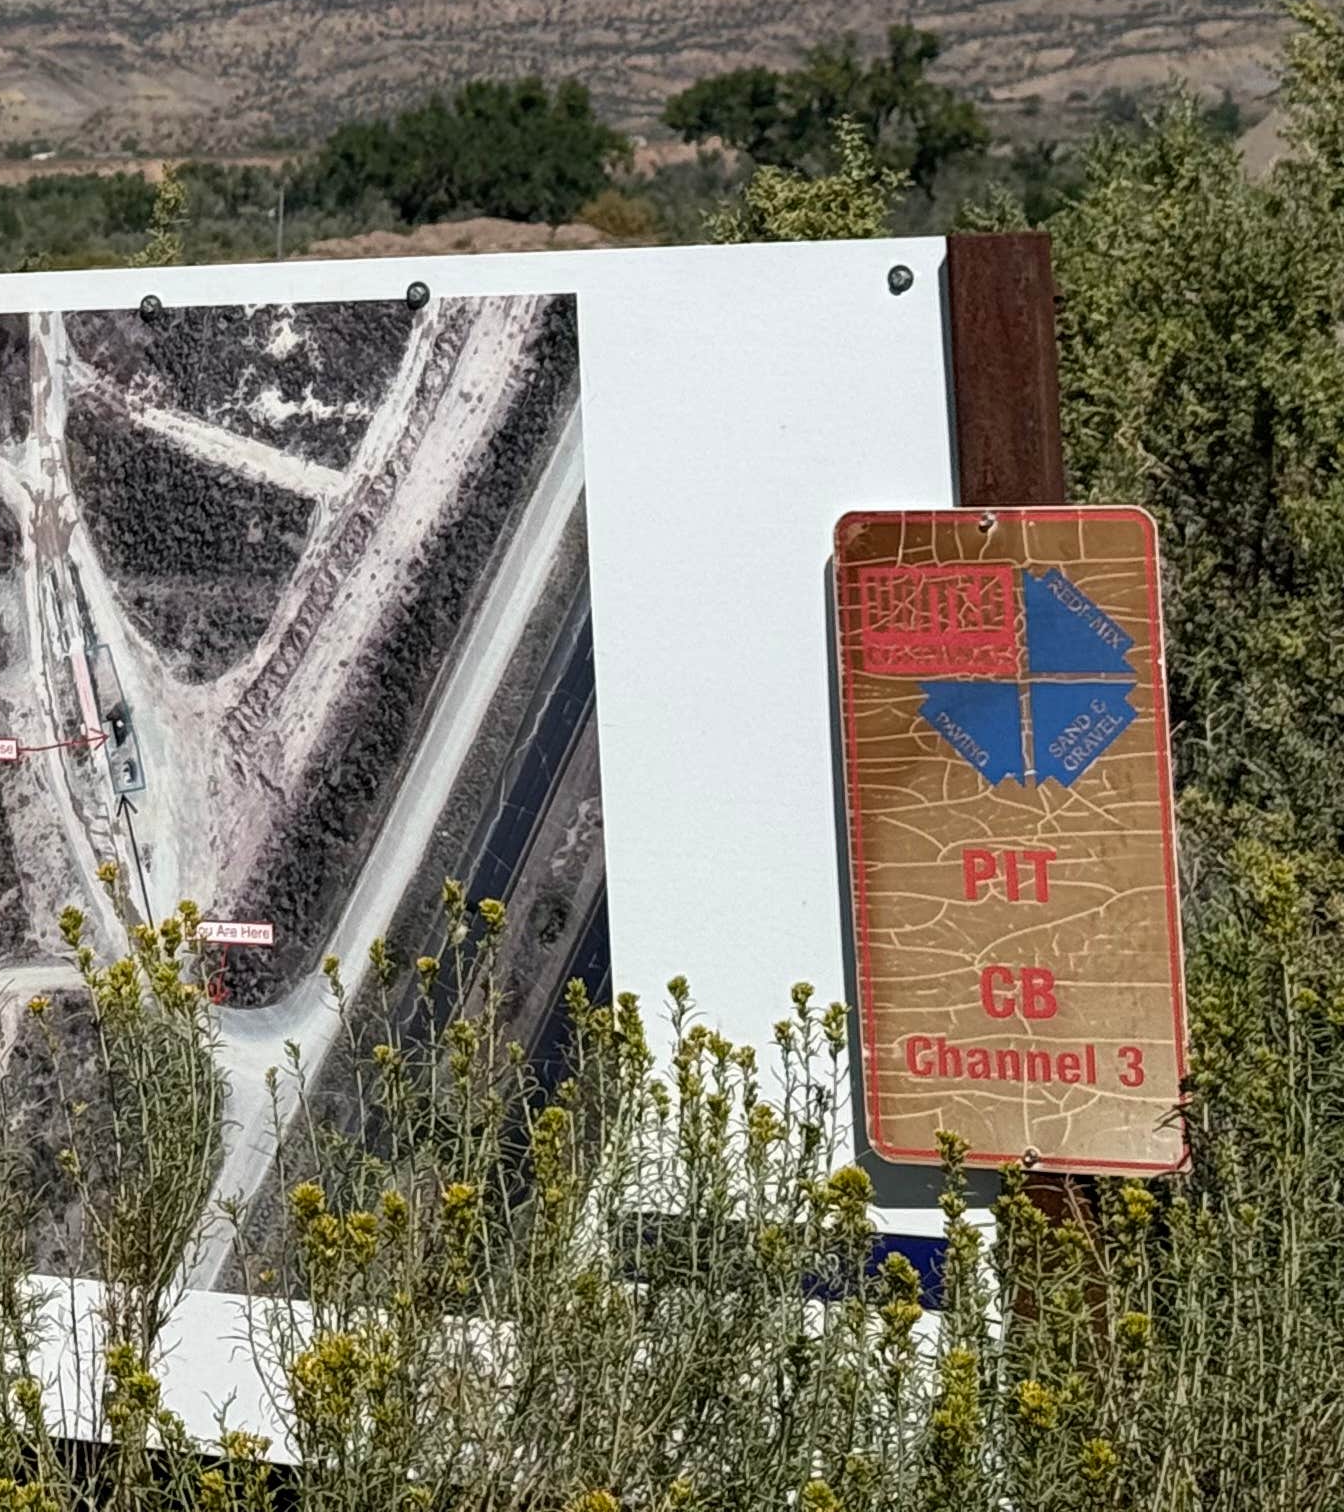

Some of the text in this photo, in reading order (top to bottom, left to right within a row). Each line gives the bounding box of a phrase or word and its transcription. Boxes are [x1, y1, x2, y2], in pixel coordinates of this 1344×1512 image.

[1047, 575, 1126, 649] REDI-MIX
[935, 710, 991, 768] PAVING
[1048, 714, 1092, 759] SAND
[1062, 714, 1124, 772] GRAVEL
[962, 848, 1057, 903] PIT
[216, 925, 238, 937] Are
[241, 925, 270, 940] Here
[979, 965, 1058, 1020] CB
[905, 1035, 1145, 1087] Channel 3
